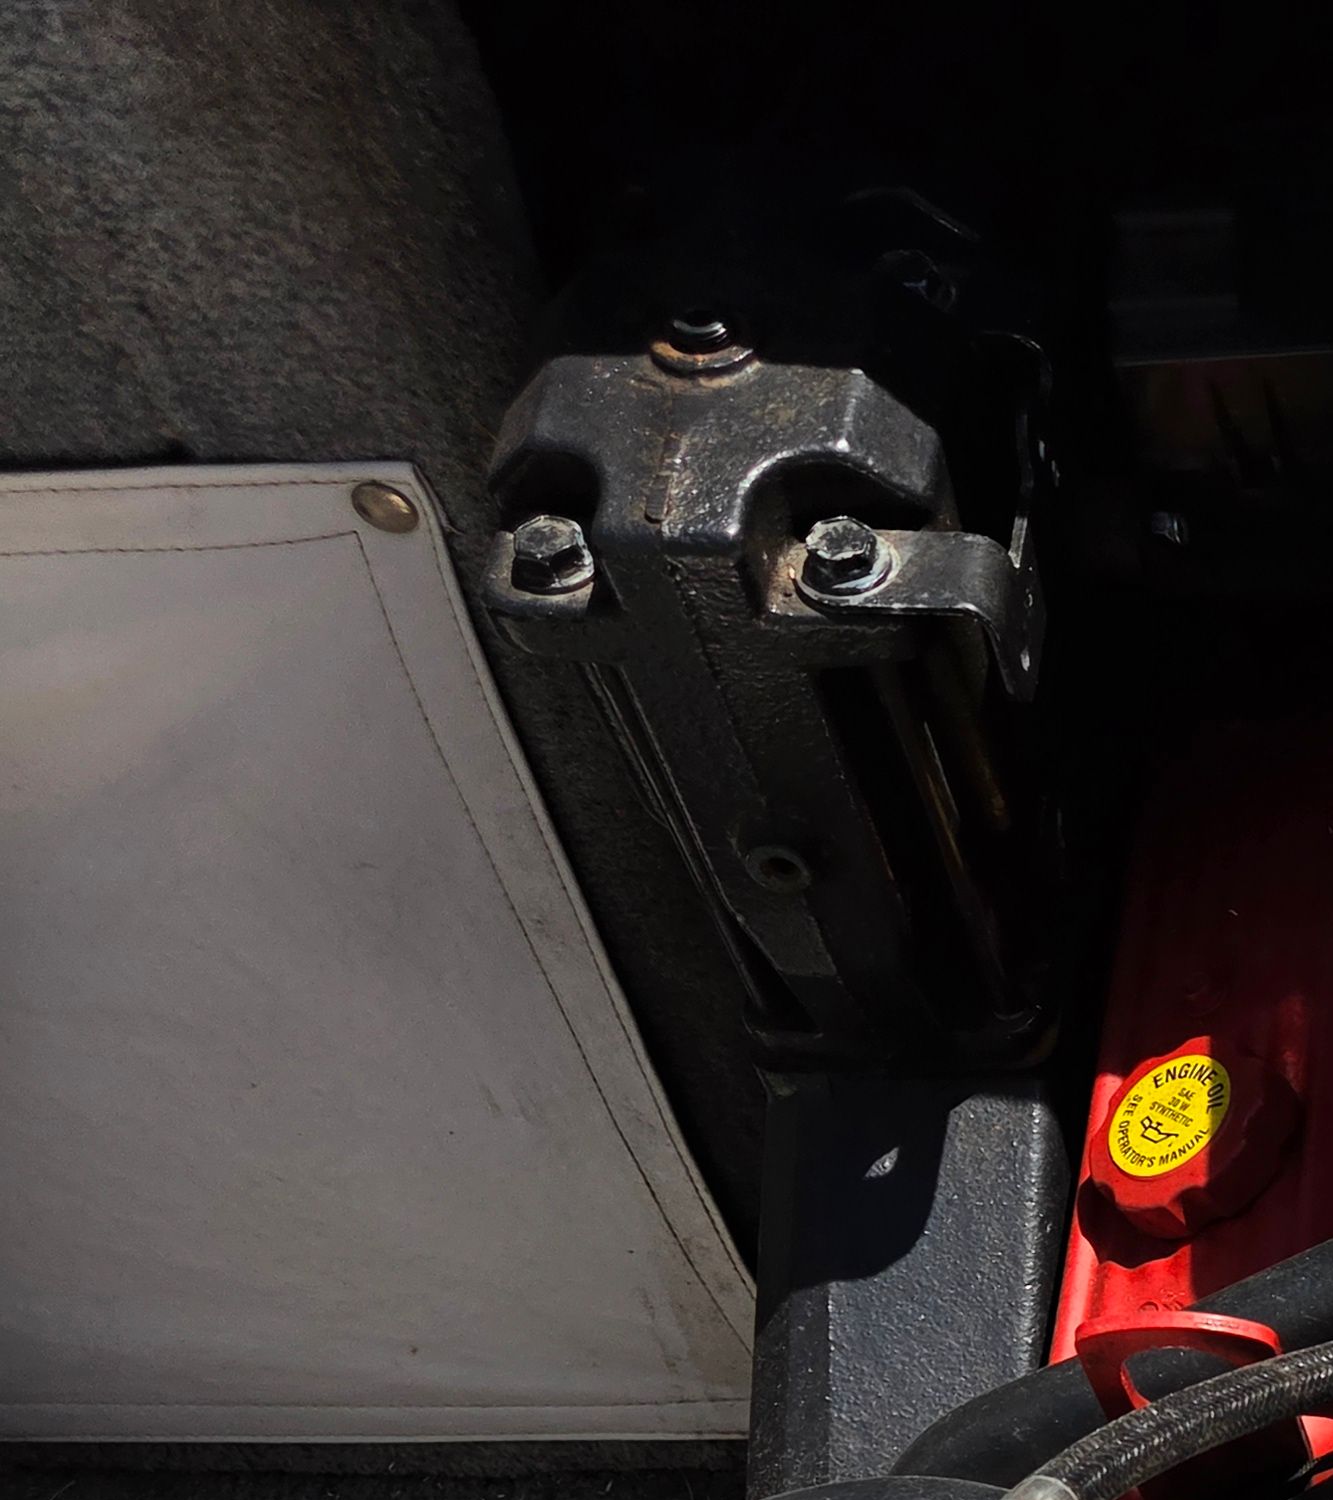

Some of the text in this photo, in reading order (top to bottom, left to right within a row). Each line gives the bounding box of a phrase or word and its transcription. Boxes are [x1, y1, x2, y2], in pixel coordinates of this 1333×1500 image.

[1153, 1063, 1225, 1114] ENGINE OIL
[1178, 1088, 1196, 1101] SAE
[1118, 1094, 1210, 1168] SEE OPERATOR'S MANUAL
[1149, 1101, 1194, 1127] SYNTHETIC
